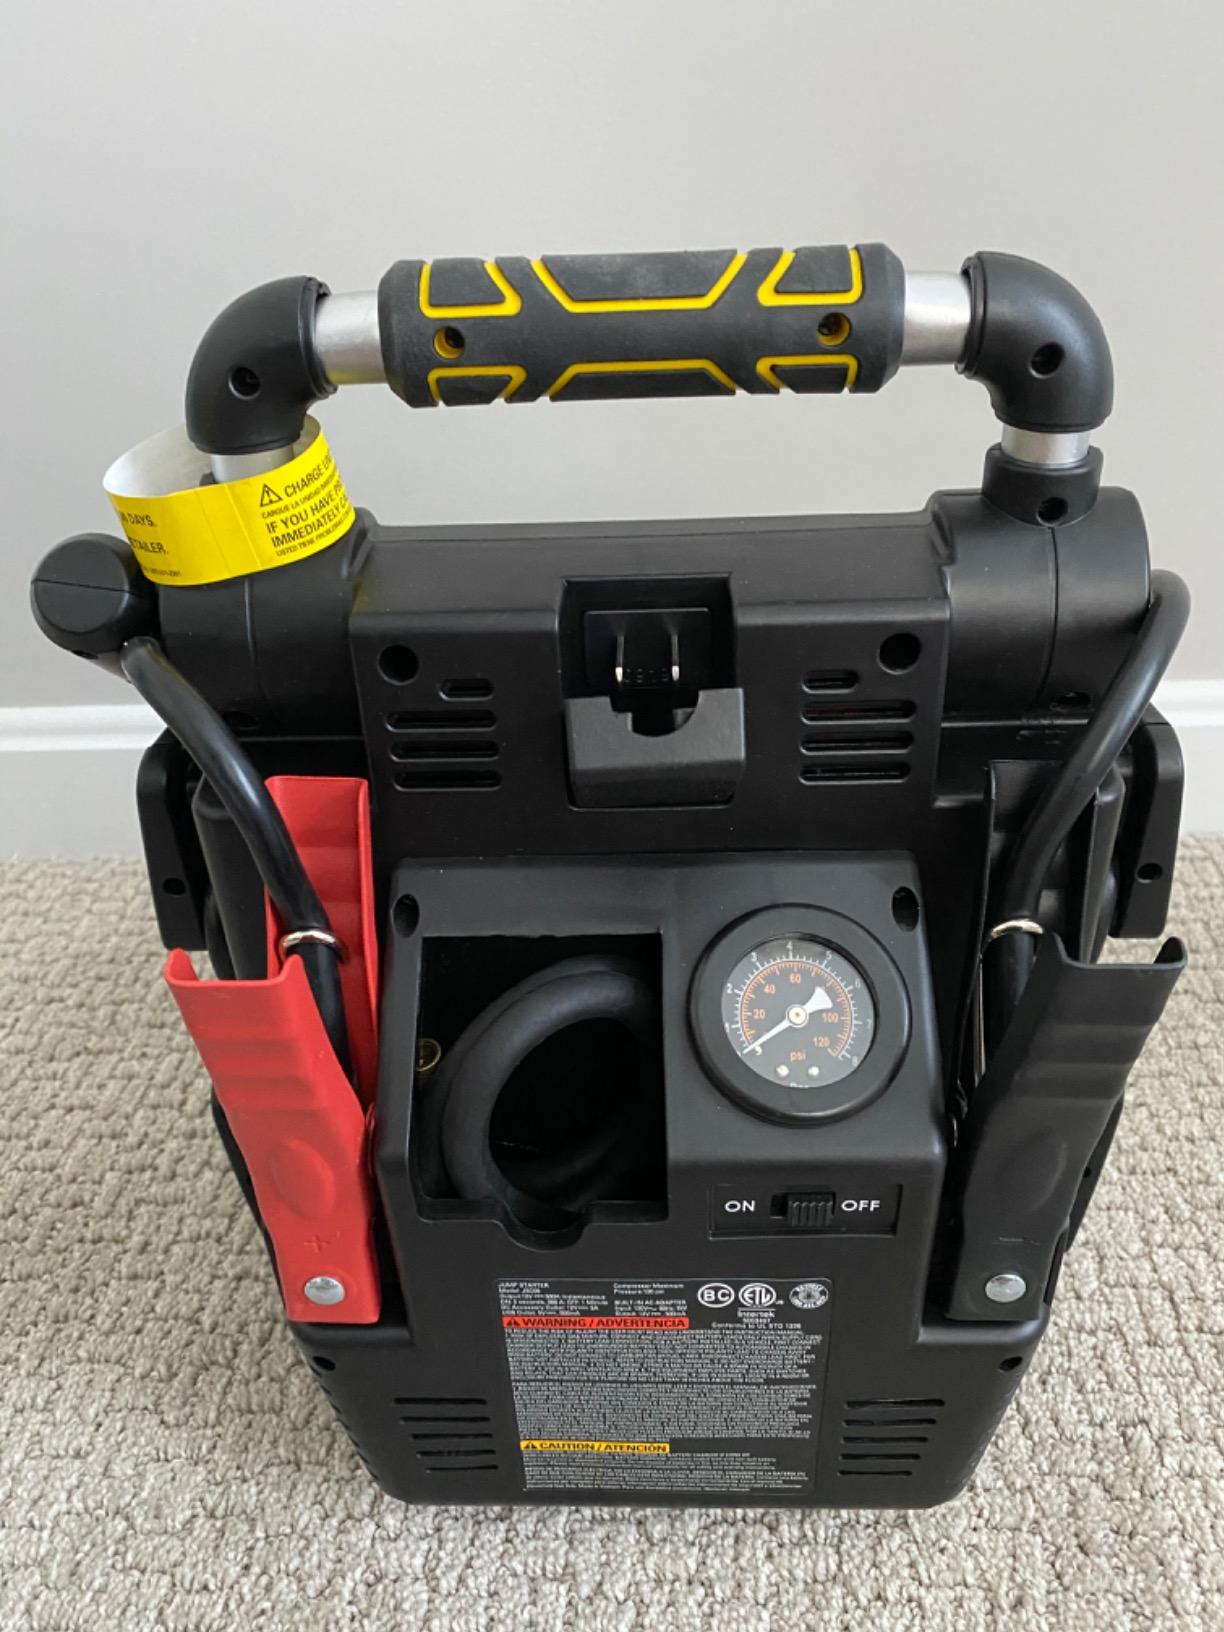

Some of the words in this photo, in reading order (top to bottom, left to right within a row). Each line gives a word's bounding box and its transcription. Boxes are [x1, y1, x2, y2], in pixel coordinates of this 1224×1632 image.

[284, 463, 323, 497] CHARGE
[265, 521, 278, 534] IF
[280, 510, 309, 529] YOU
[309, 489, 334, 516] HAVE
[271, 504, 341, 548] IMMEDIATELY
[785, 940, 793, 950] 4
[751, 952, 758, 962] 3
[825, 951, 833, 960] 5
[789, 973, 801, 984] 60
[726, 983, 733, 994] 2
[763, 984, 776, 995] 40
[753, 1009, 766, 1020] 20
[822, 1012, 839, 1023] 100
[812, 1036, 830, 1048] 120
[789, 1051, 807, 1062] psi
[724, 1200, 755, 1213] ON
[841, 1200, 881, 1212] OFF
[703, 1289, 730, 1302] BC
[523, 1318, 587, 1327] WARNING
[596, 1318, 686, 1328] ADVERTENCIA
[540, 1442, 596, 1451] CAUTION
[604, 1442, 667, 1453] ATENCIÓN
